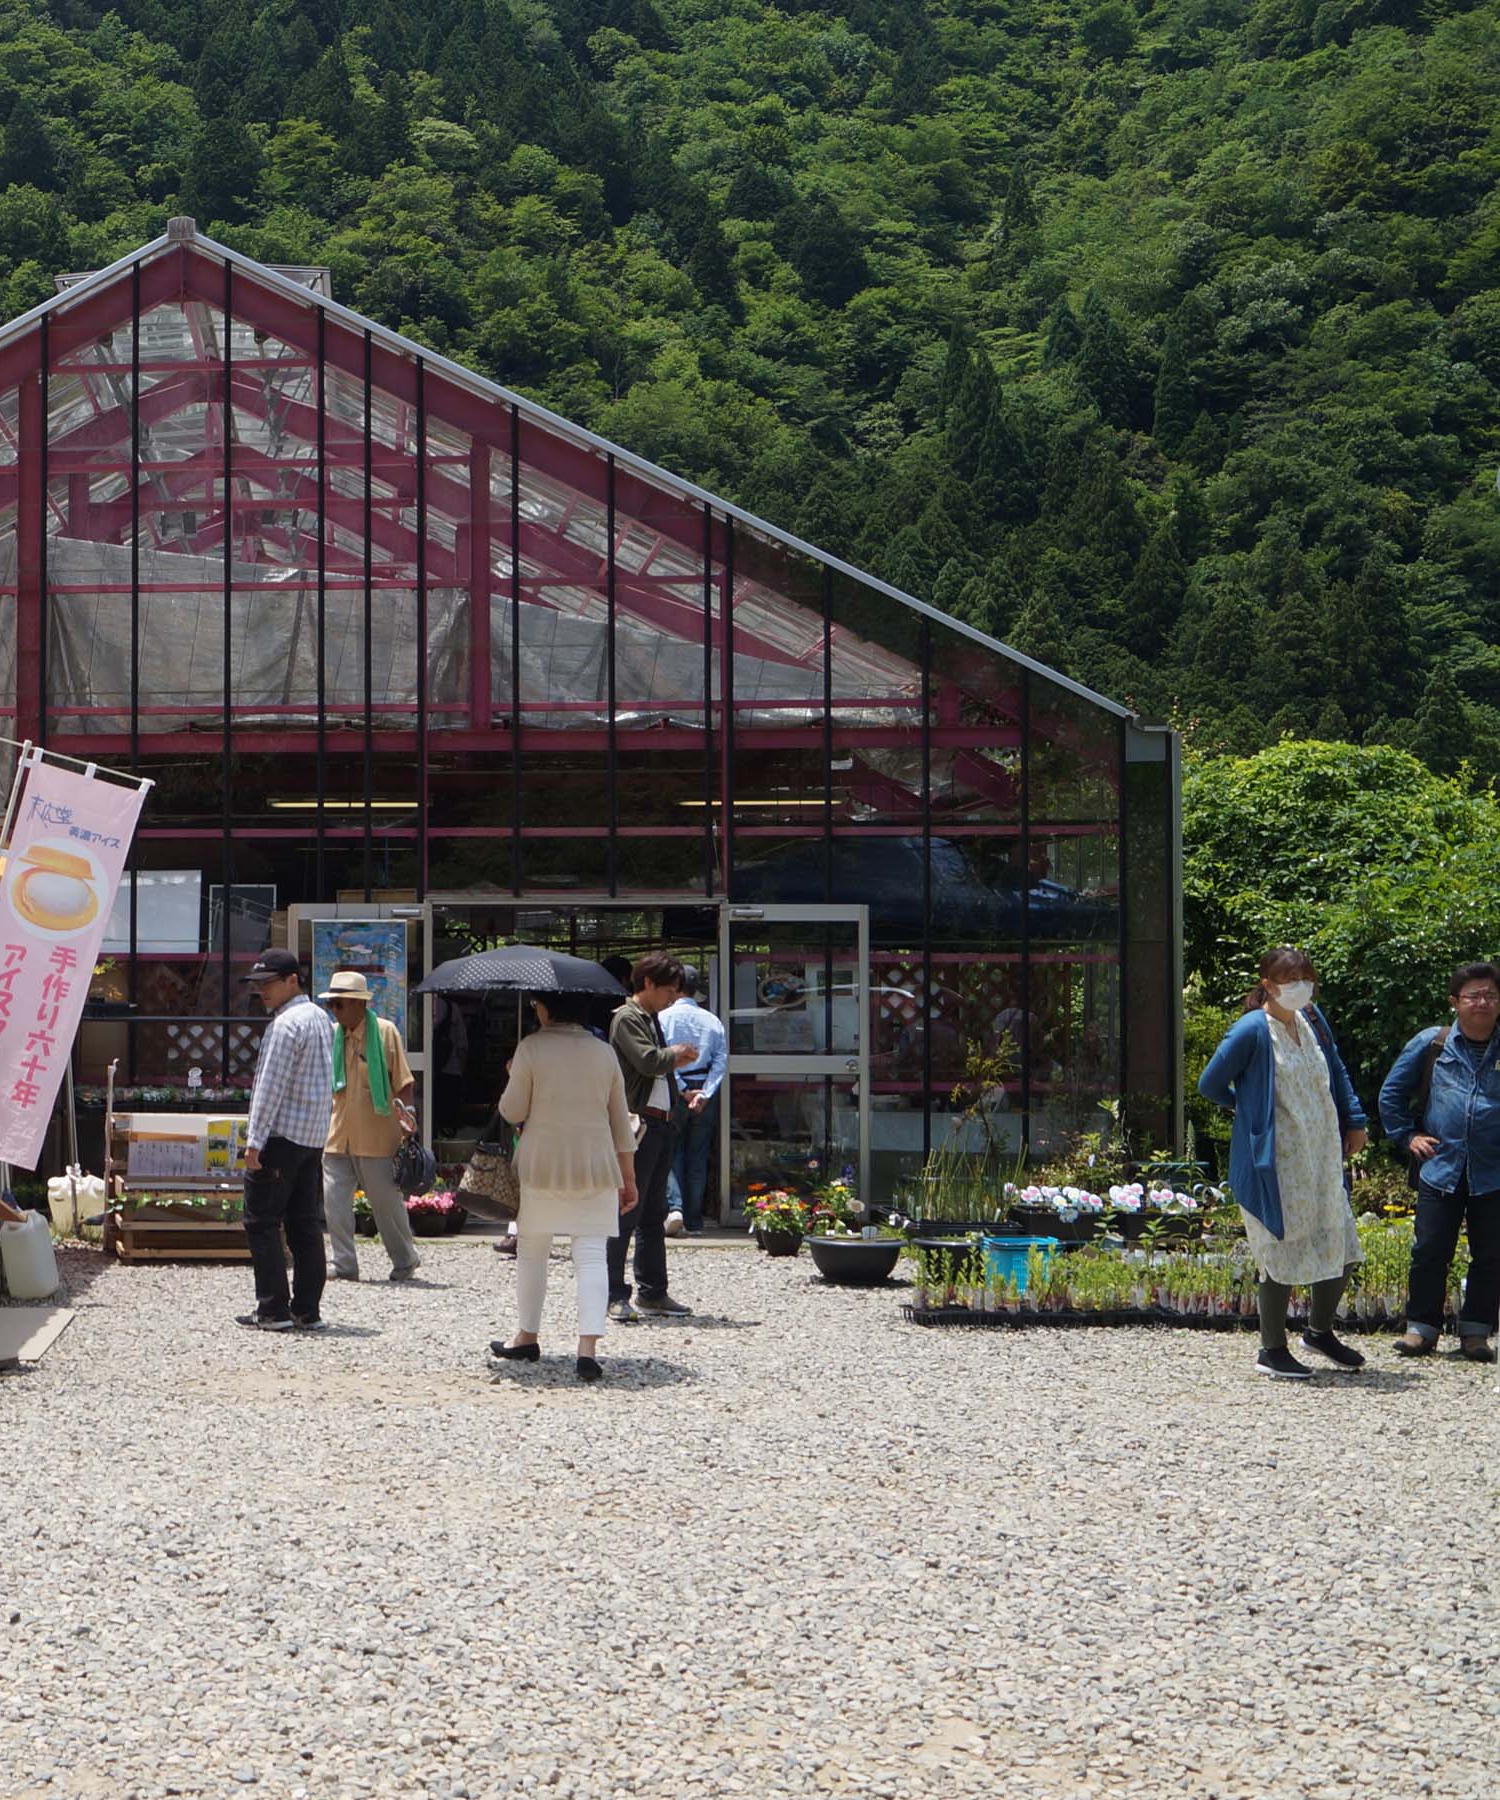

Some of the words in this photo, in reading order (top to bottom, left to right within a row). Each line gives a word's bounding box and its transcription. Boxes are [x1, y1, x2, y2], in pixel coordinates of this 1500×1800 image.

[11, 946, 77, 1108] 手作り六十年
